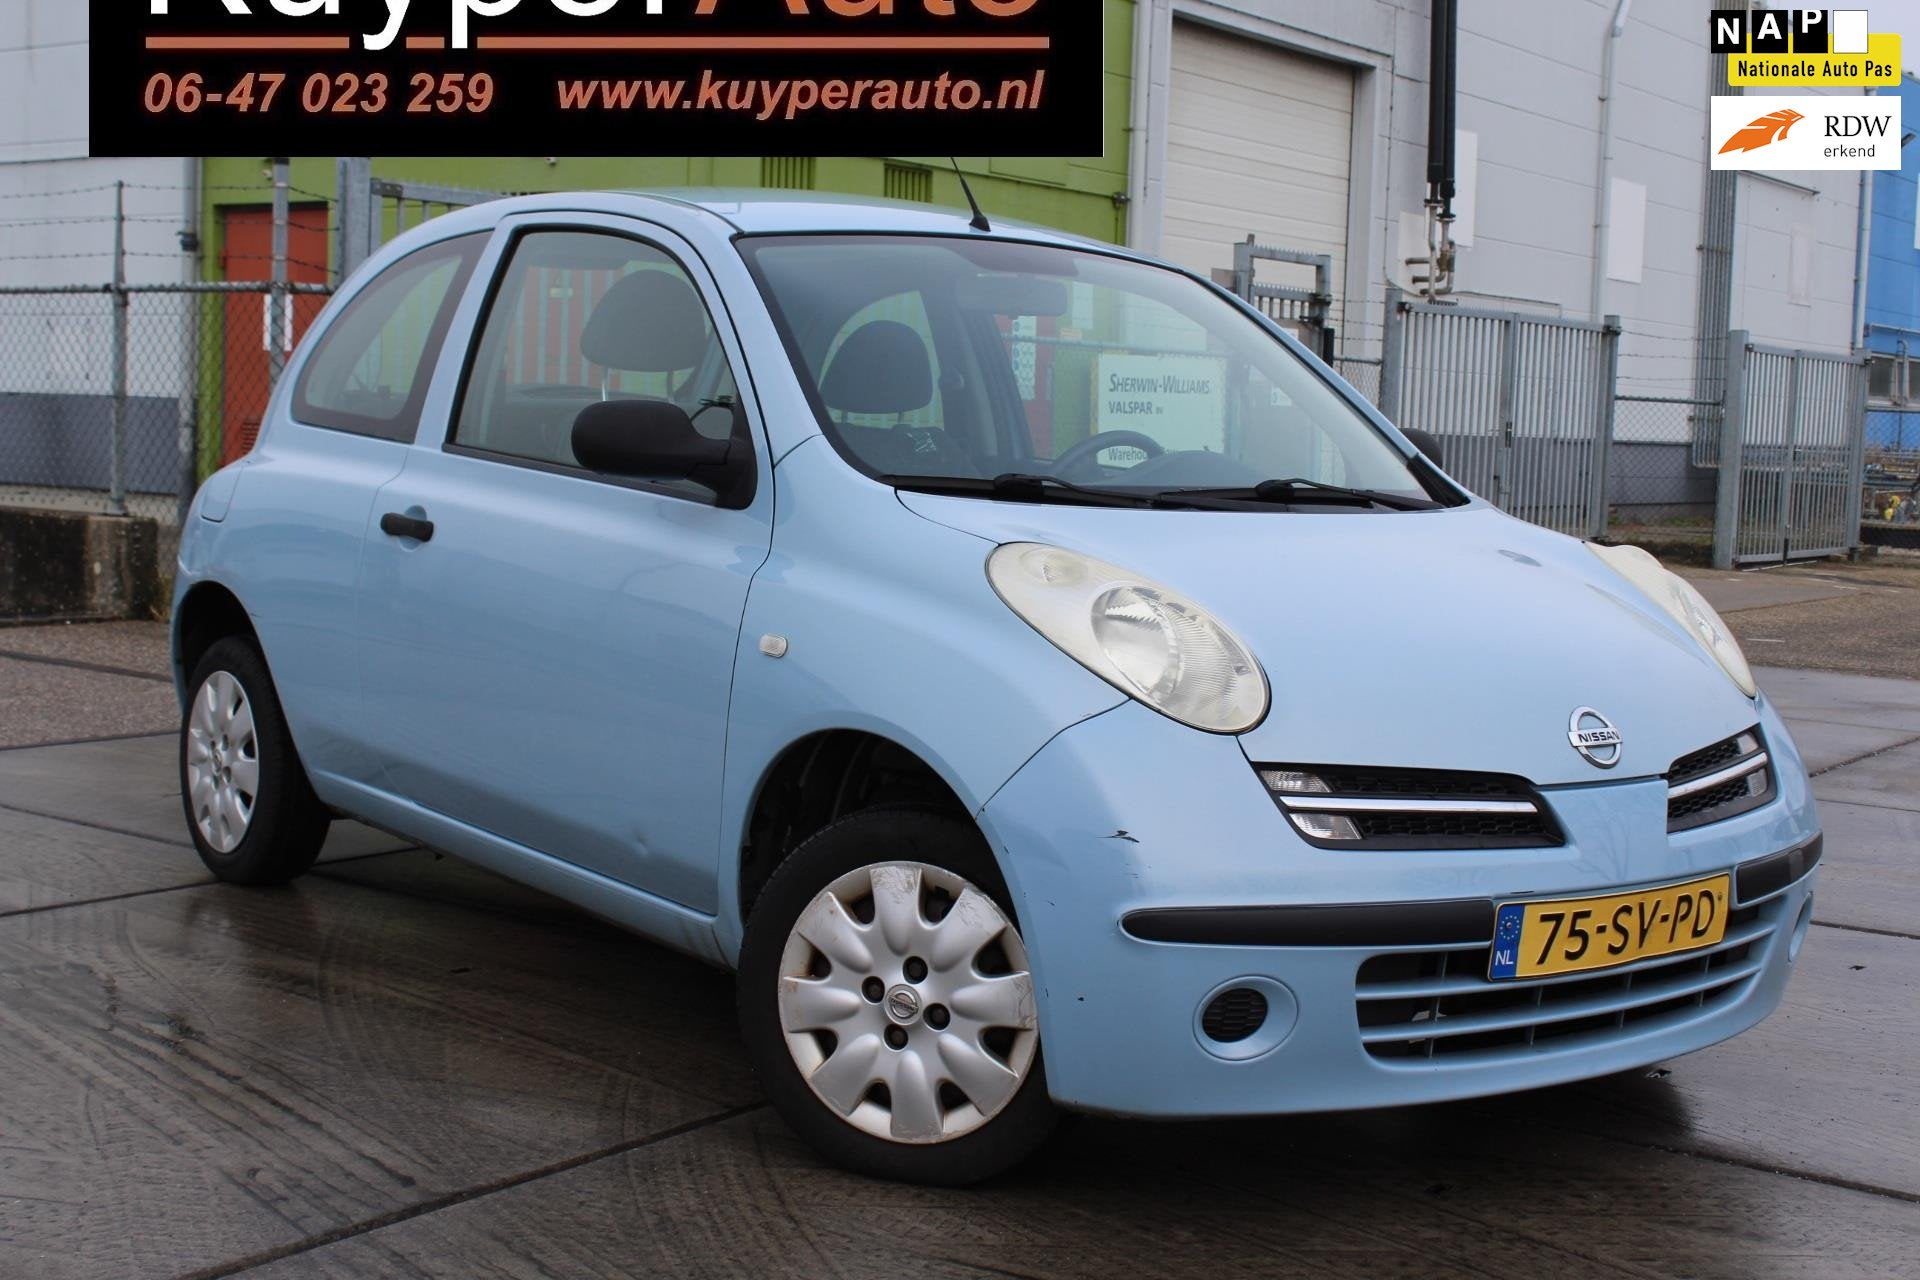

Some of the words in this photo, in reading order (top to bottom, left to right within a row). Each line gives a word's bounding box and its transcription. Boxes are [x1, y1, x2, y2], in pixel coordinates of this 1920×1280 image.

[1108, 401, 1153, 415] VALSPAR
[1577, 730, 1620, 744] NISSAN
[1536, 889, 1716, 966] 75-SV-PD
[1494, 950, 1514, 966] NL
